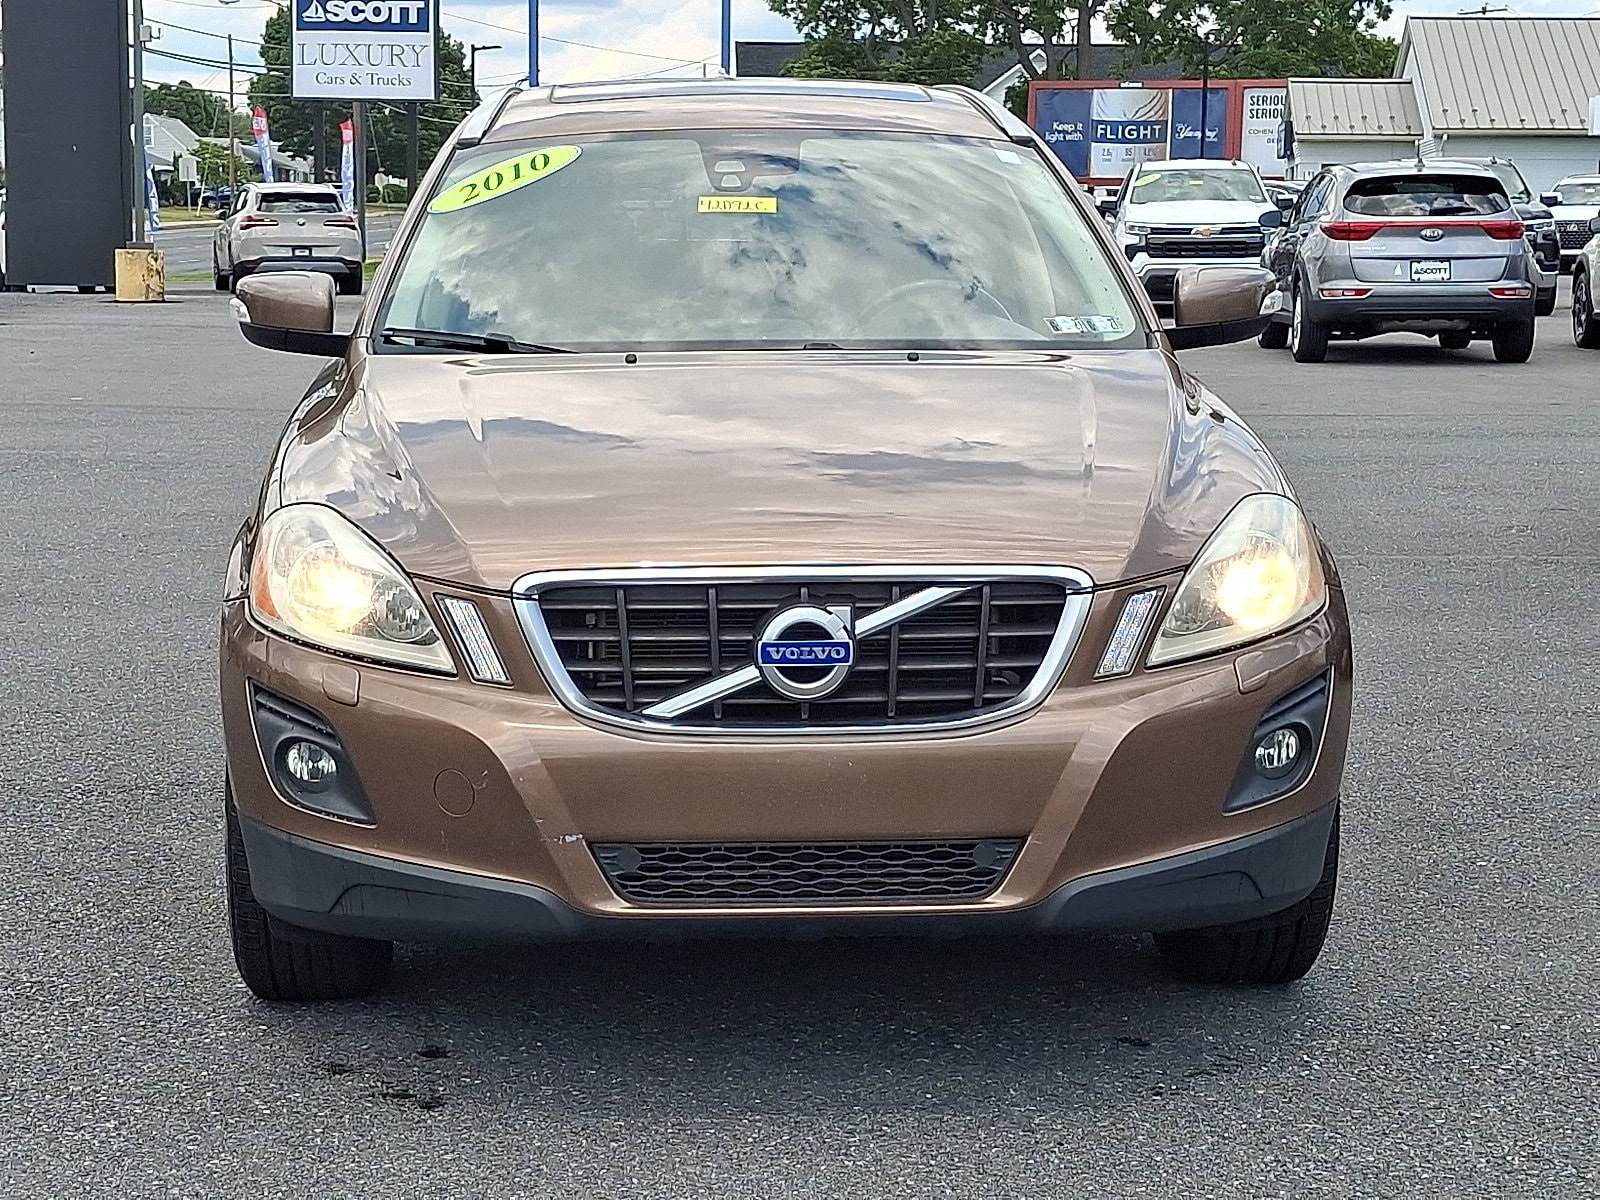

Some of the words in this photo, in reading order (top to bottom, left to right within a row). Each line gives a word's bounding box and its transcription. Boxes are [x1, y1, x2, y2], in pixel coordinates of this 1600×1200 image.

[325, 0, 425, 24] SCOTT
[297, 42, 428, 67] LUXURY
[315, 71, 345, 85] Cars
[349, 72, 362, 86] &
[366, 72, 412, 87] Trucks
[1053, 121, 1075, 133] Keep
[1077, 121, 1083, 131] it
[1096, 124, 1162, 139] FLIGHT
[1045, 131, 1064, 143] light
[1065, 131, 1083, 141] with
[459, 153, 550, 204] 2010
[1420, 267, 1448, 275] SCOTT
[766, 646, 846, 660] VOLVO
